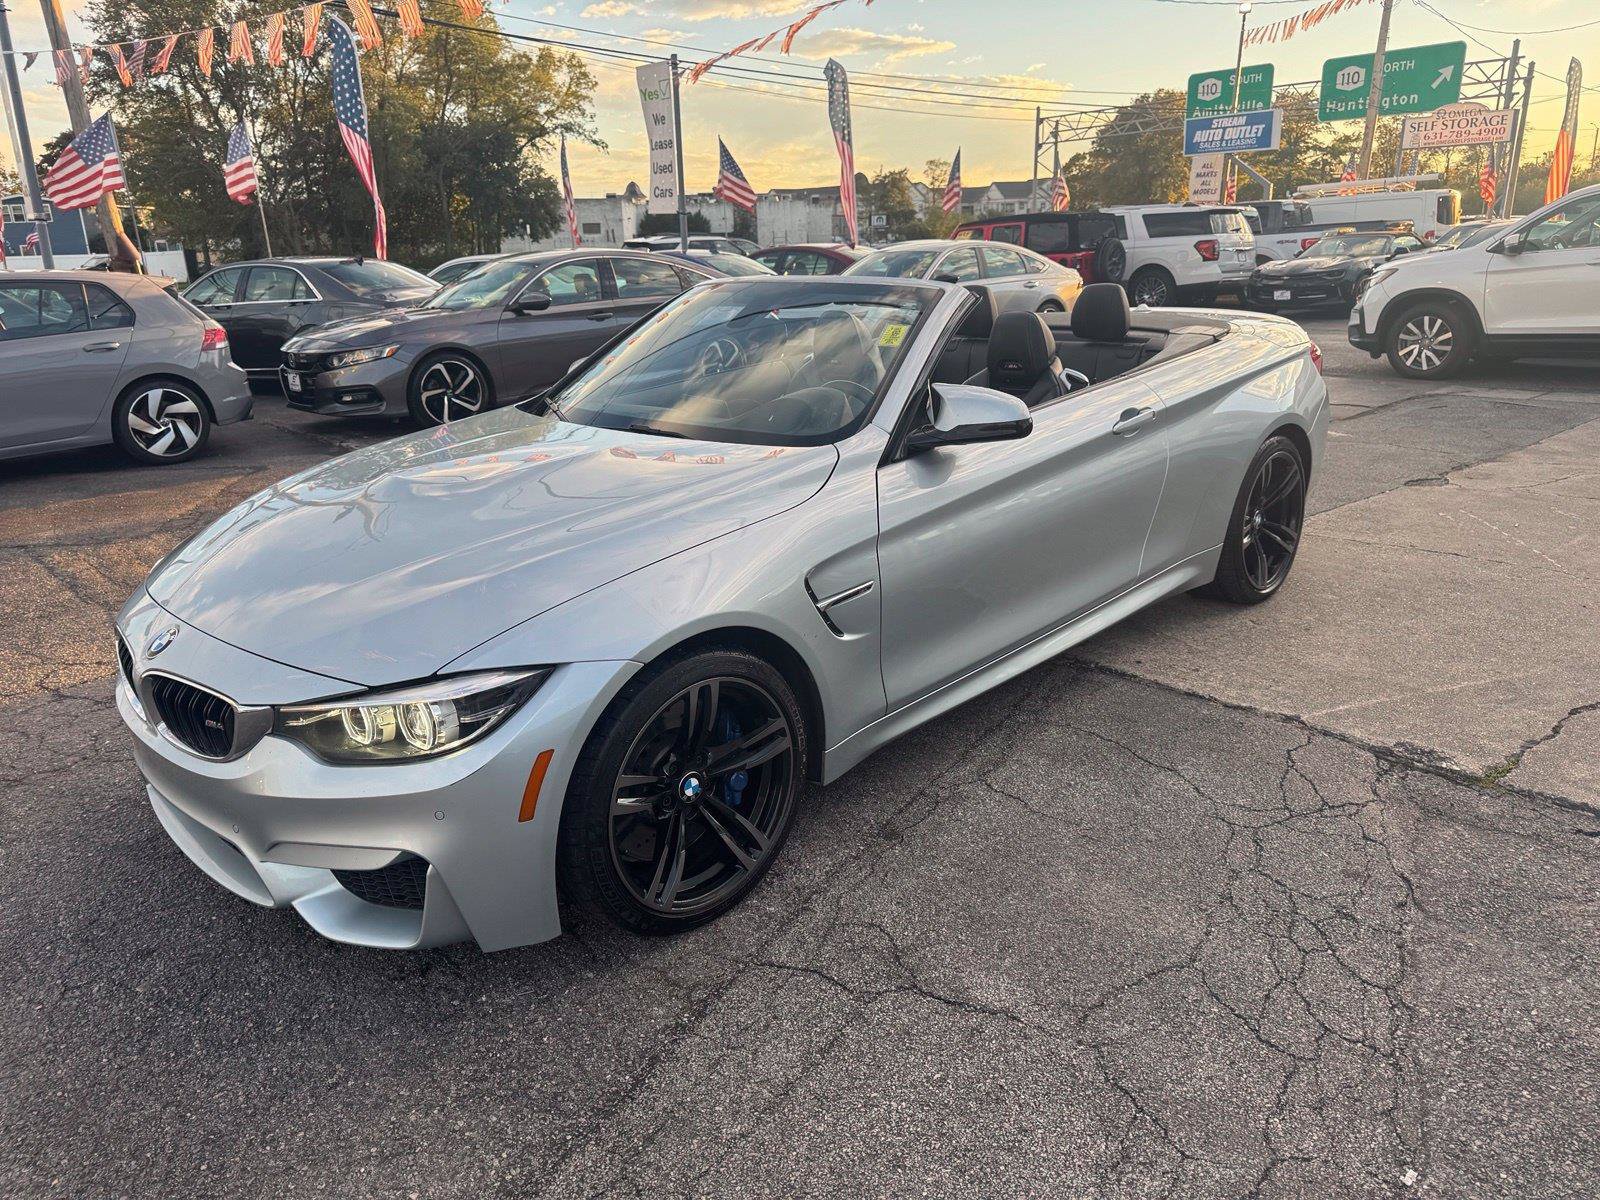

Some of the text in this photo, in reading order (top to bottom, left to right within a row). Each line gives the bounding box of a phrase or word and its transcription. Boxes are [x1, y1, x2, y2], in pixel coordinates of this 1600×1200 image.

[1340, 59, 1415, 86] 110 ORTH
[640, 87, 659, 101] Yes
[1202, 83, 1218, 97] 110
[1326, 93, 1419, 112] Huntigton
[652, 113, 666, 126] We
[1448, 108, 1482, 118] OMEGA
[1211, 116, 1247, 128] STREAM
[1409, 114, 1508, 133] SELF STORAGE
[1193, 124, 1266, 143] AUTO OUTLET
[1423, 127, 1506, 141] 631-789-4900
[650, 138, 673, 151] Lease
[1199, 140, 1221, 149] SALES
[1227, 137, 1257, 147] LEASING
[652, 162, 673, 175] Used
[653, 185, 673, 199] Cars
